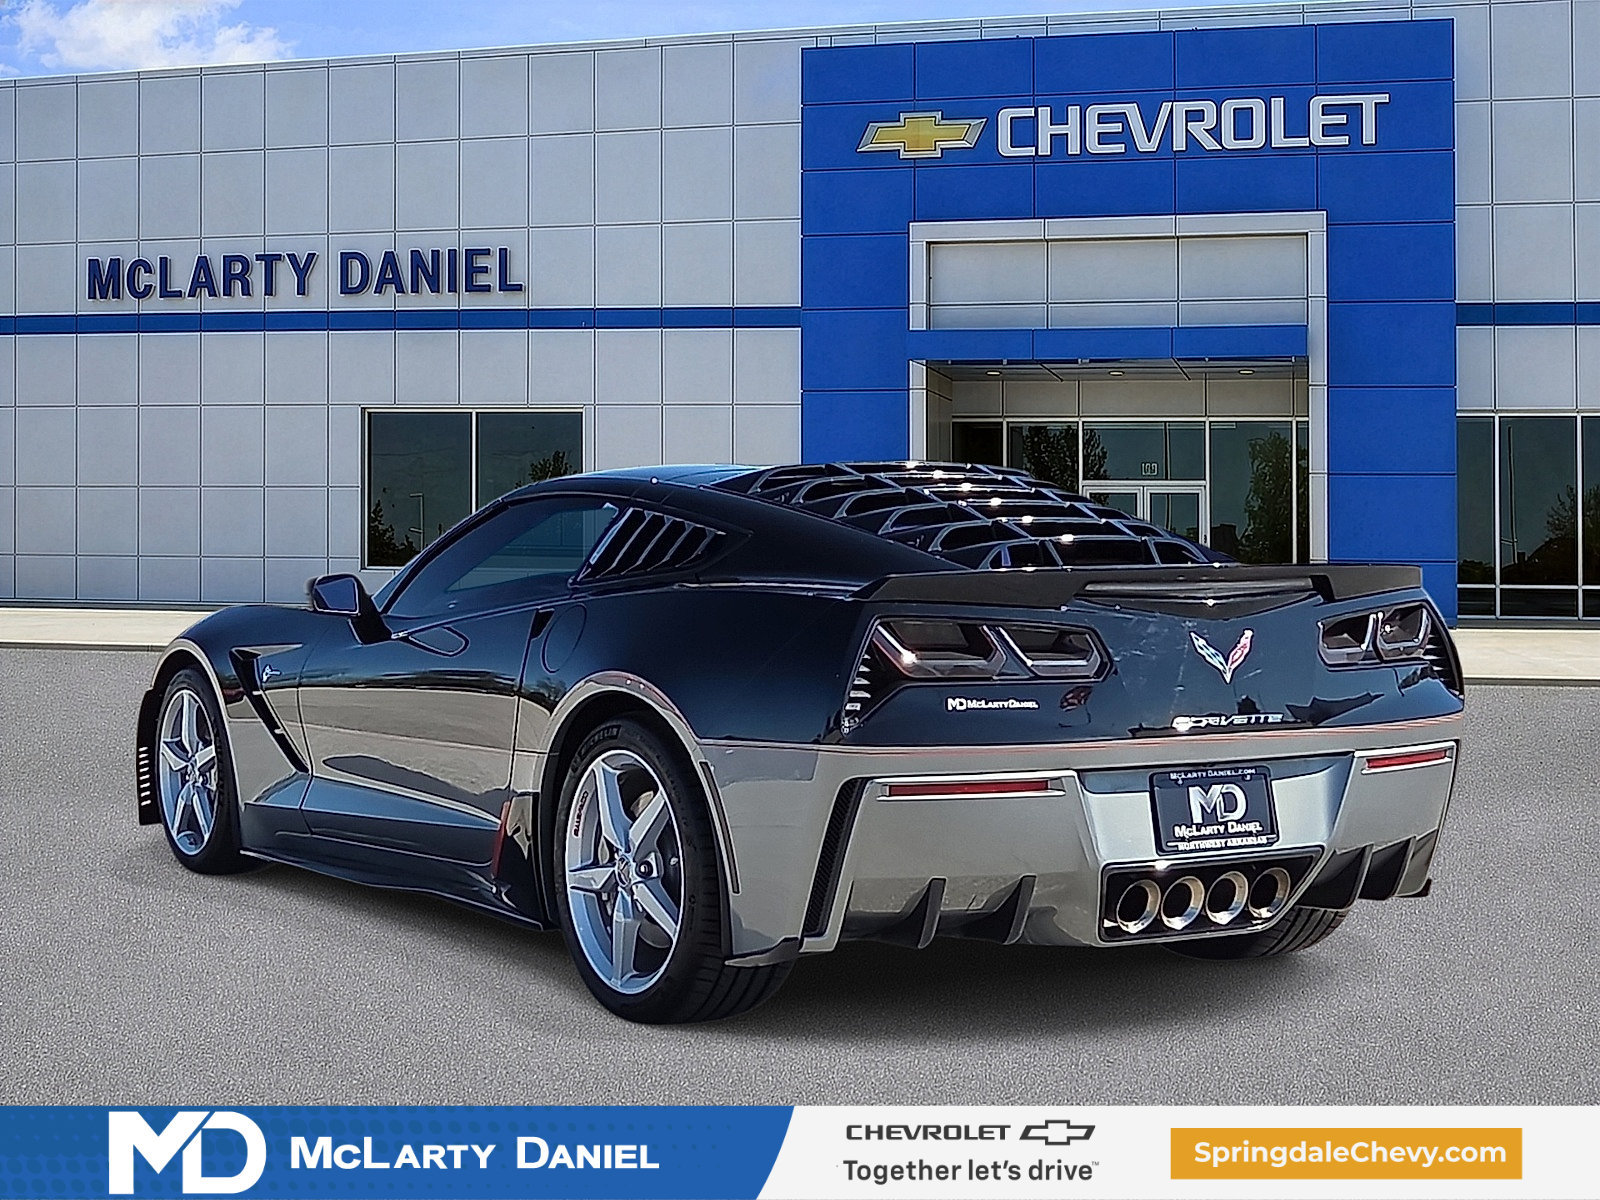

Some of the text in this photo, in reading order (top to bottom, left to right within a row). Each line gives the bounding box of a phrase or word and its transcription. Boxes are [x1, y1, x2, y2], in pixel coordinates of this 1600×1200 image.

[997, 92, 1391, 158] CHEVROLET
[340, 246, 524, 296] DANIEL
[1188, 783, 1247, 824] MD
